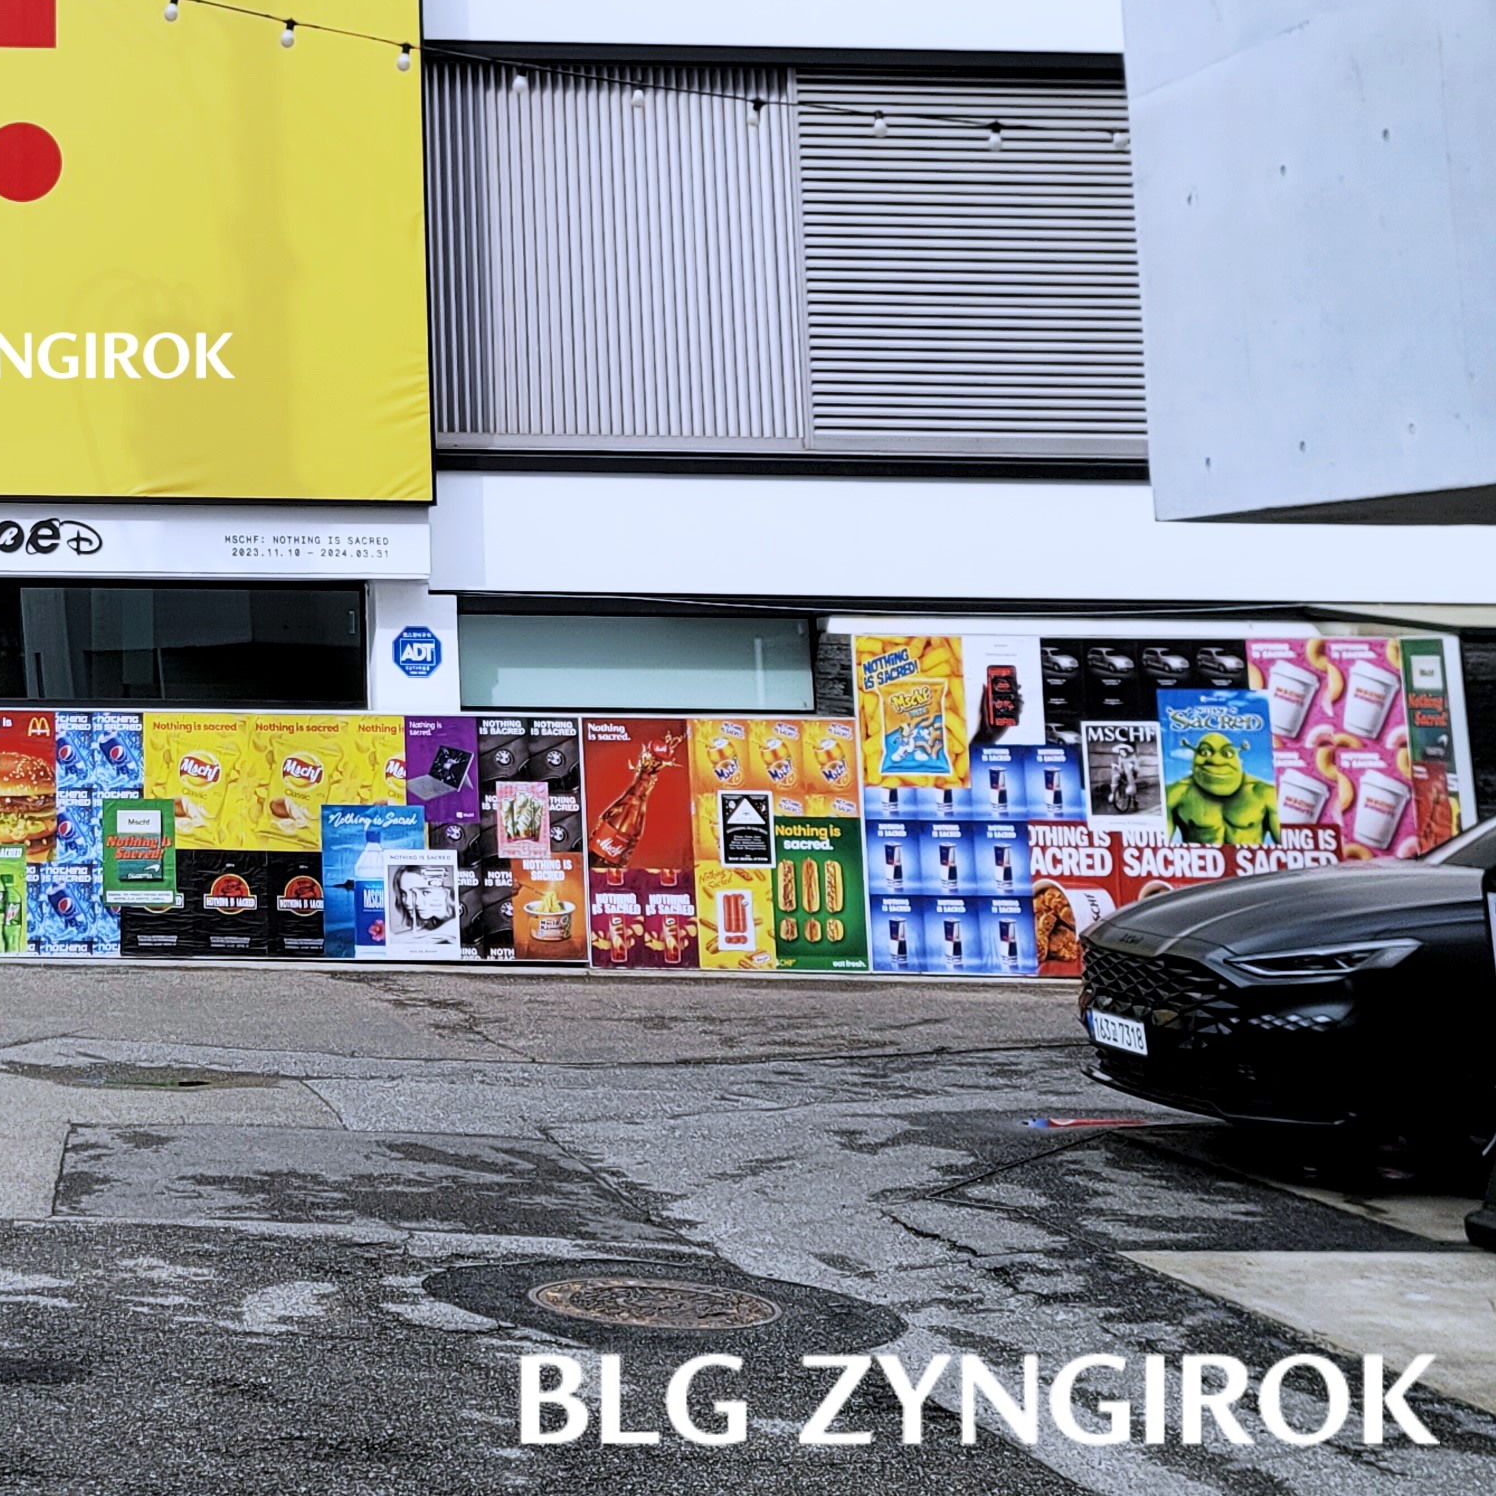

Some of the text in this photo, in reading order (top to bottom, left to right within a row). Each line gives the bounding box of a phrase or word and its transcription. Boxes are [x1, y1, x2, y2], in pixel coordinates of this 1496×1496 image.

[224, 535, 390, 546] MSCHF: NOTHING IS SACRED
[231, 548, 301, 557] 2023.11.10
[320, 548, 390, 558] 2024.03.31
[401, 643, 435, 662] ADT
[862, 648, 909, 676] NOTHING
[877, 659, 920, 686] SACRED!
[2, 716, 12, 728] is
[153, 721, 238, 734] Nothing is sacred
[409, 720, 437, 731] Nothing
[482, 719, 522, 729] NOTHING
[533, 720, 573, 730] NOTHING
[587, 722, 626, 734] Nothing
[255, 722, 340, 735] Nothing is sacred
[358, 723, 397, 736] Nothing
[479, 727, 526, 736] IS SACRED
[530, 728, 577, 737] IS SACRED
[588, 733, 631, 741] is sacred.
[549, 796, 577, 805] THING
[549, 804, 580, 812] ACRED
[329, 812, 371, 831] Nothing
[775, 824, 841, 840] Nothing is
[783, 838, 834, 851] sacred.
[522, 859, 573, 871] NOTHING IS
[1030, 847, 1113, 878] ACRED
[1122, 848, 1226, 878] SACRED
[488, 871, 513, 879] NOTH
[531, 870, 566, 881] SACRED
[495, 879, 513, 887] SAC
[363, 889, 385, 908] MSCH
[490, 947, 515, 956] NOTH
